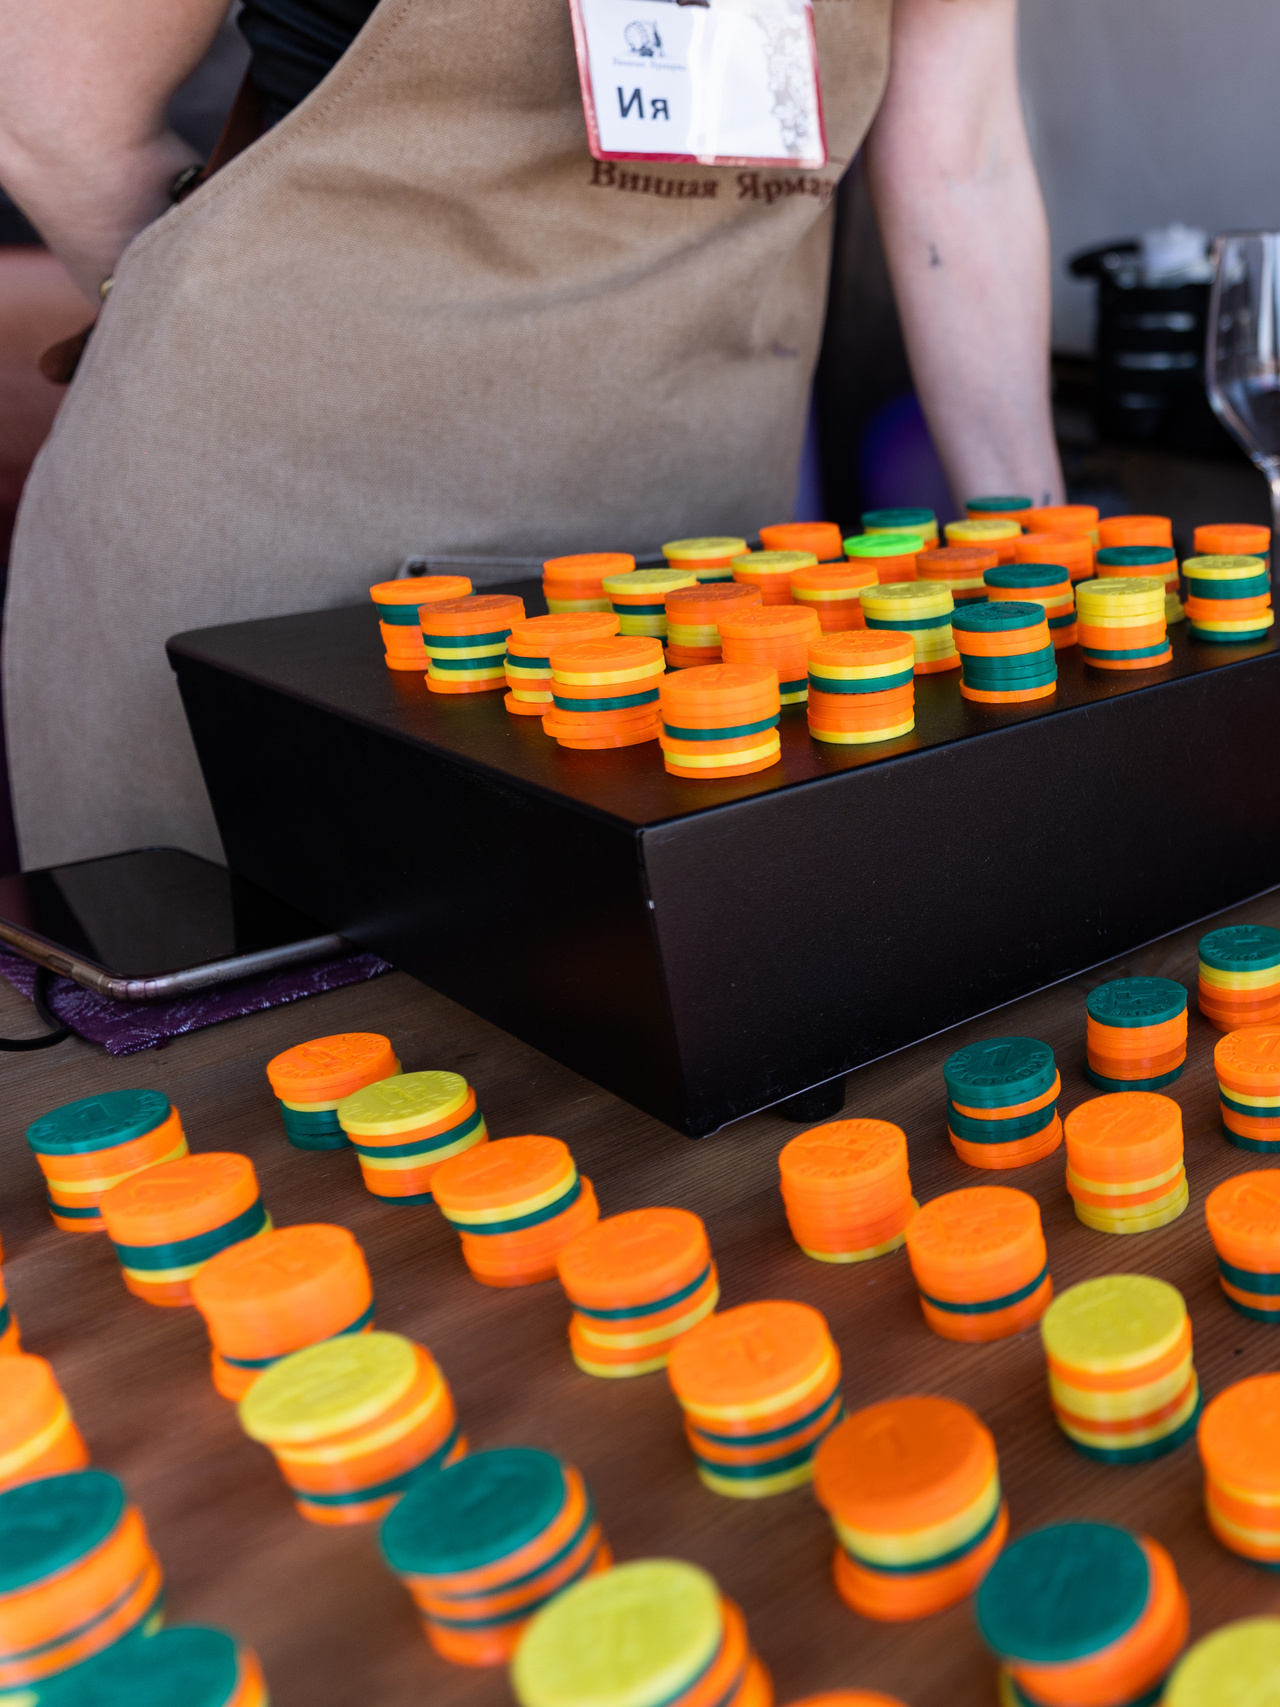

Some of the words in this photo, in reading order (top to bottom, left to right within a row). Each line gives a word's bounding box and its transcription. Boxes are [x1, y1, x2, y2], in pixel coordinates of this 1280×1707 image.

[617, 86, 670, 120] Ия
[590, 160, 719, 199] Винная
[983, 1043, 1014, 1067] 1
